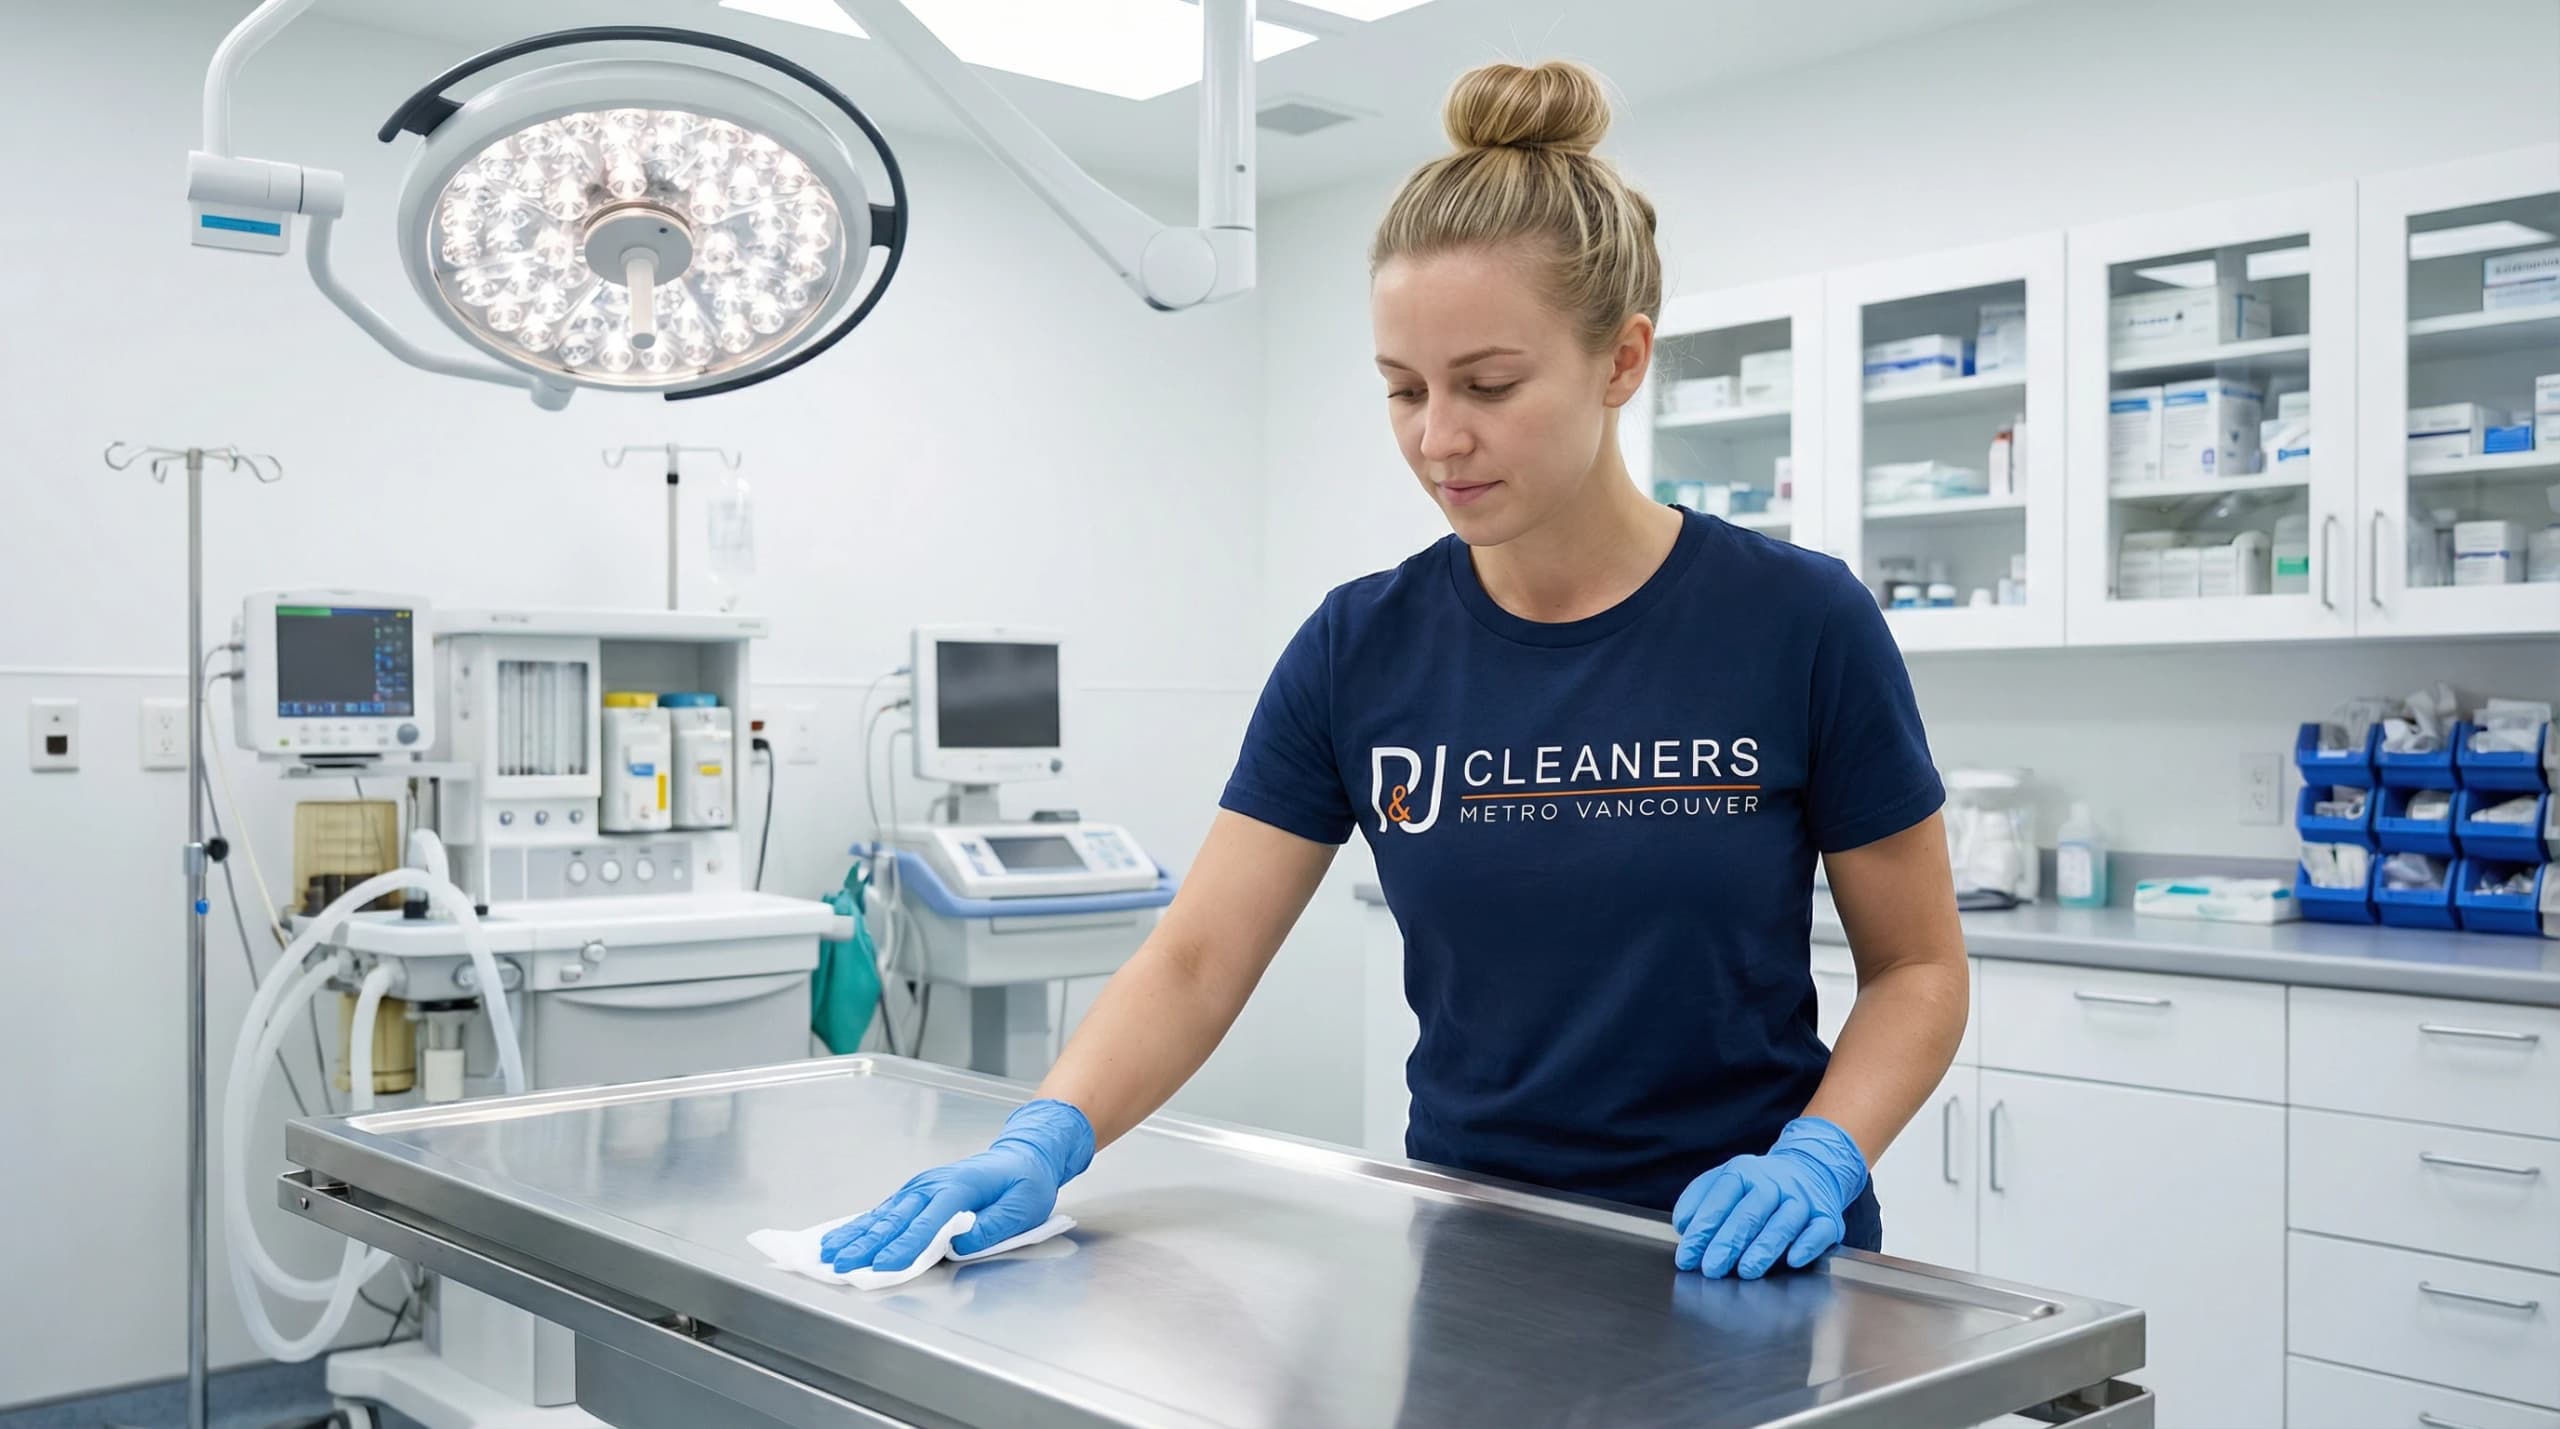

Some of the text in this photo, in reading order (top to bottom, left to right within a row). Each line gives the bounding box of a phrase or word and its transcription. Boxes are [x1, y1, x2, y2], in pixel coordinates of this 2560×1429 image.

[1464, 737, 1760, 787] CLEANERS
[1460, 795, 1760, 824] METRO VANCOUVER
